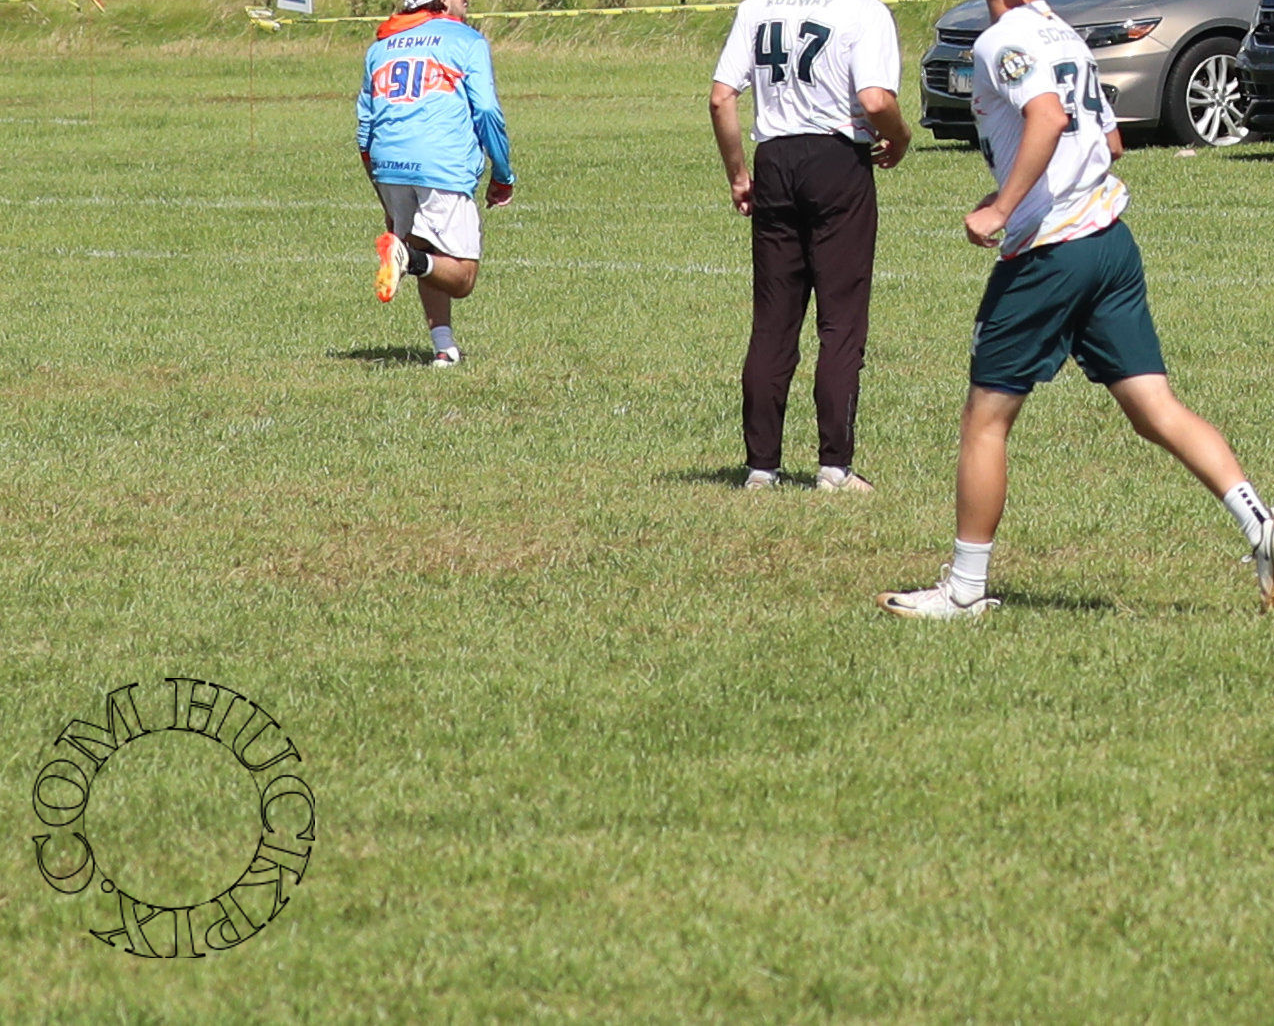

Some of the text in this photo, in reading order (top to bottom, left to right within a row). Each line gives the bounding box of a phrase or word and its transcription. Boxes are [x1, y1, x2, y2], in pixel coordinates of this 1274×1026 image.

[386, 36, 442, 50] MERWIN
[754, 19, 833, 85] 47
[388, 61, 425, 99] 91
